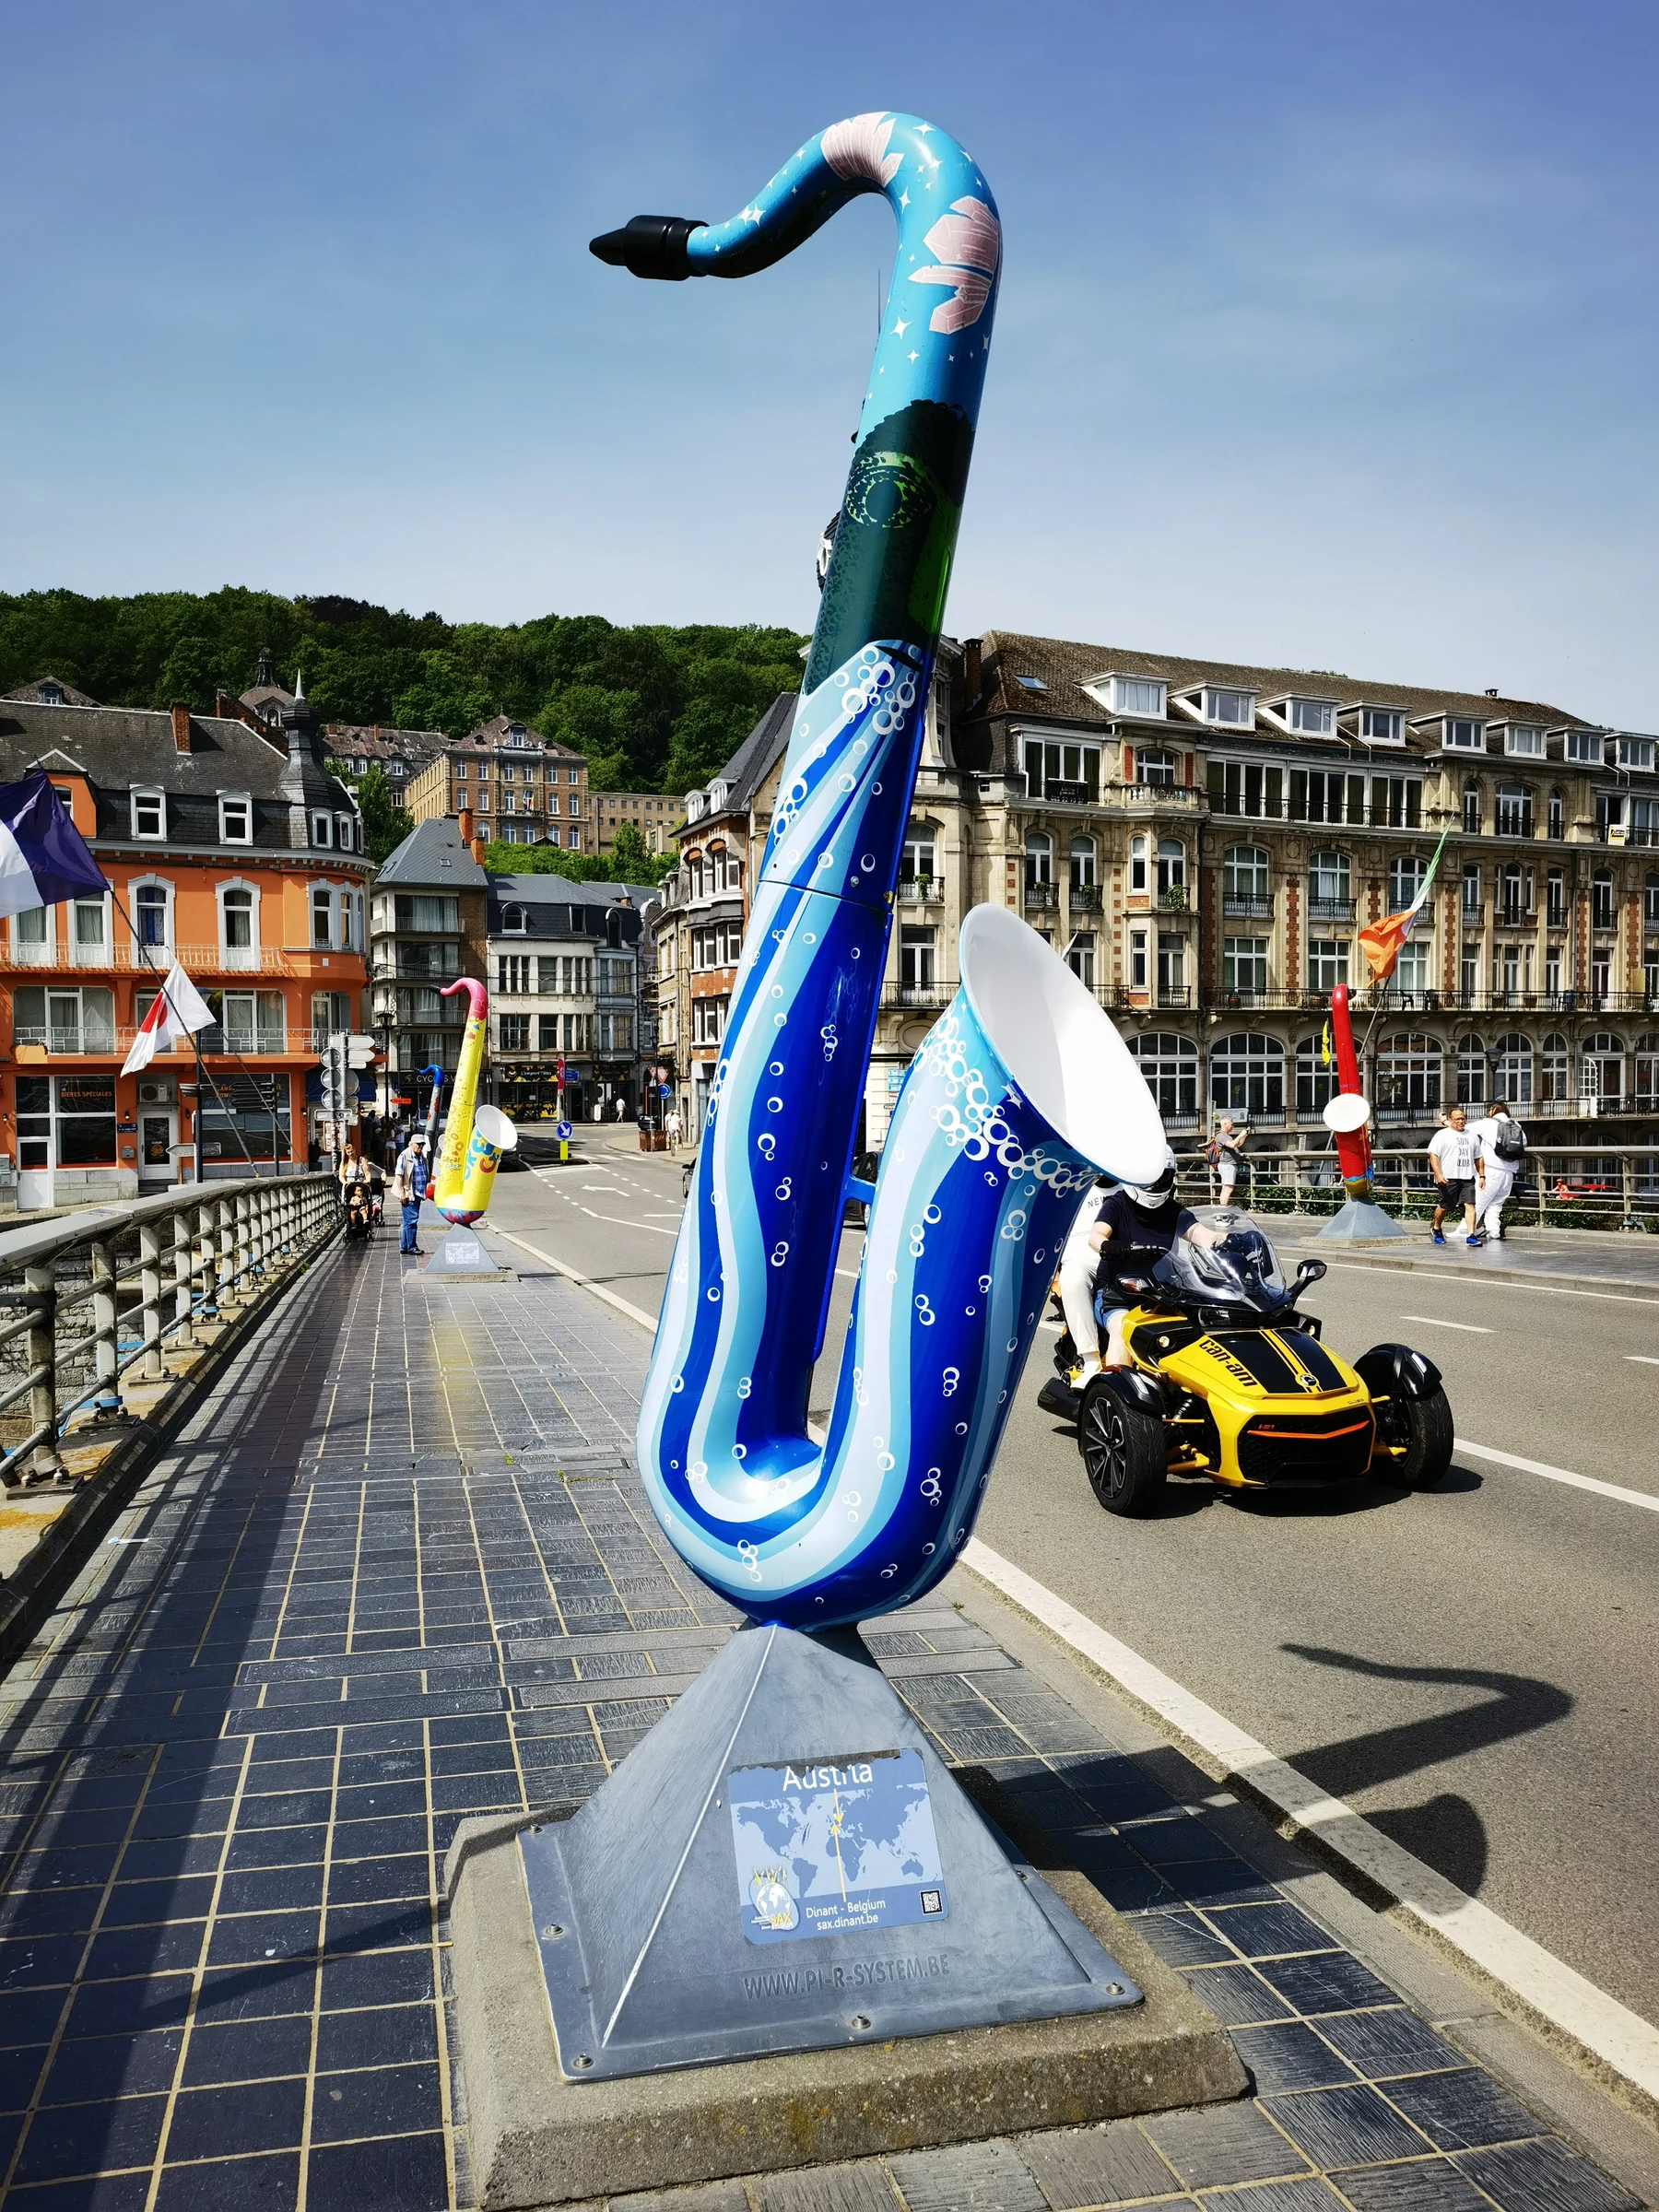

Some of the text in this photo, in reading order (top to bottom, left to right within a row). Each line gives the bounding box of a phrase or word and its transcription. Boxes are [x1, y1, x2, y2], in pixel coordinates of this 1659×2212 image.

[416, 1075, 448, 1083] CYCS
[1198, 1339, 1259, 1387] can-am
[806, 1904, 838, 1918] Dinant
[847, 1899, 887, 1913] Belgium
[770, 1912, 792, 1924] SAX
[817, 1913, 879, 1931] sax.dinant.be
[743, 1953, 950, 2000] WWW.PI-R-SYSTEM.BE
